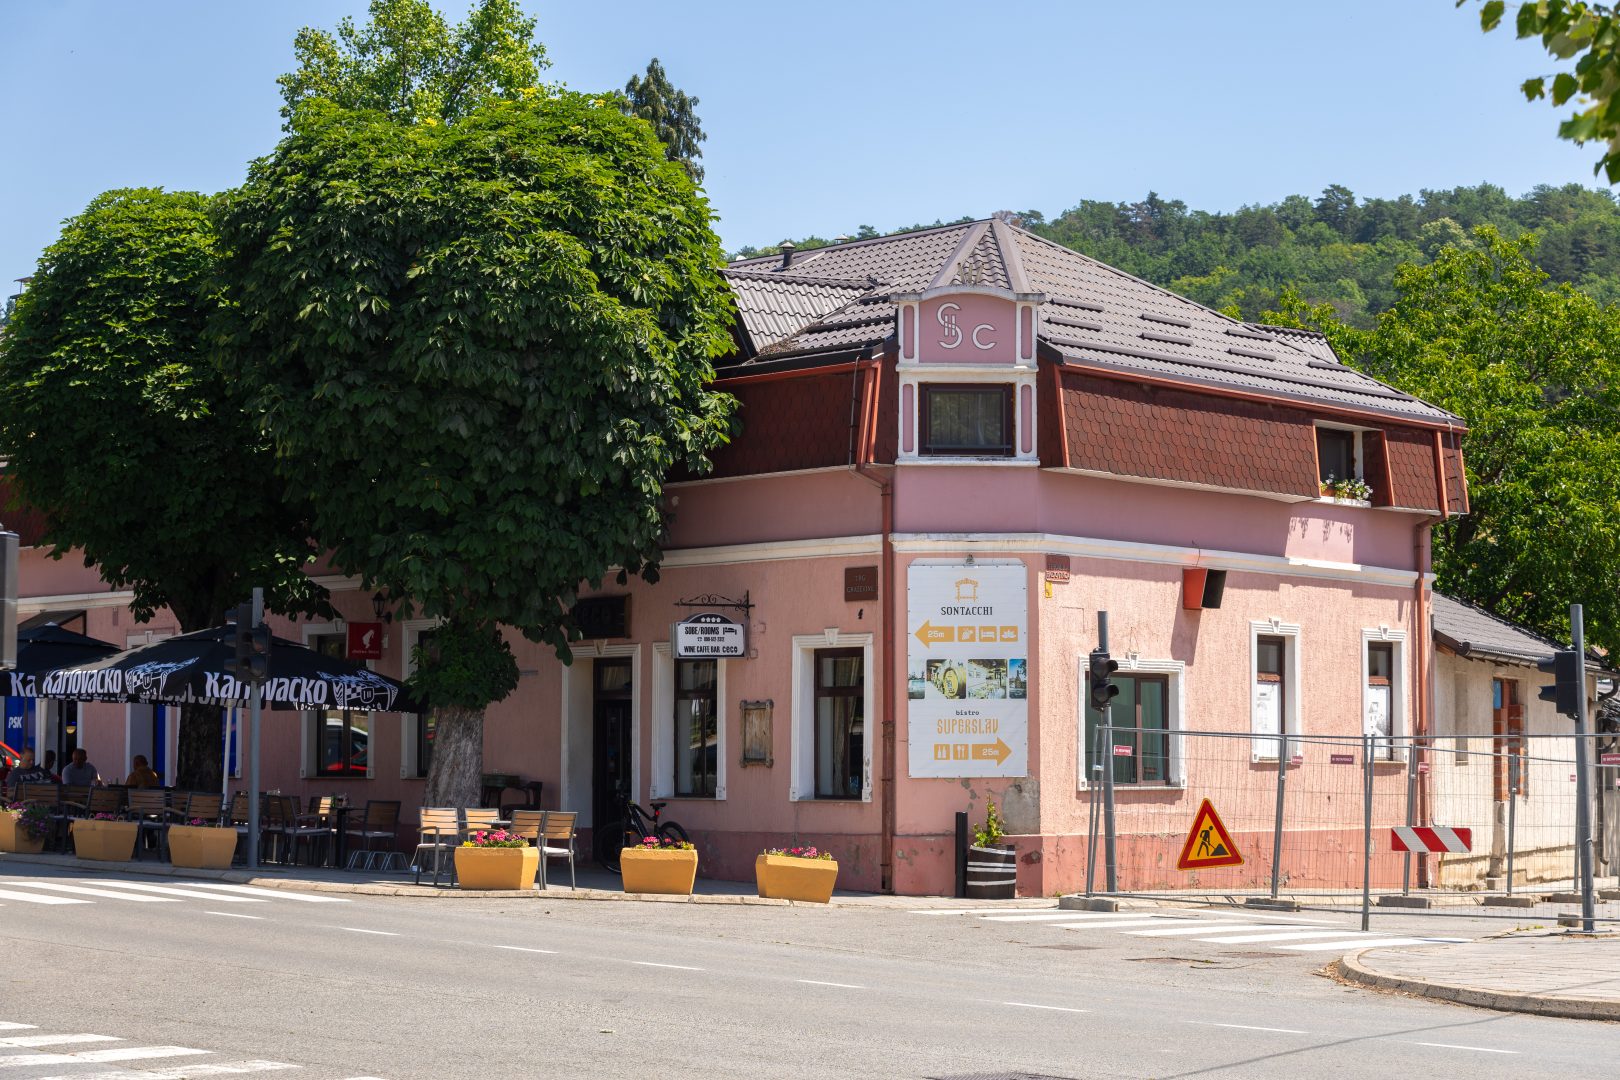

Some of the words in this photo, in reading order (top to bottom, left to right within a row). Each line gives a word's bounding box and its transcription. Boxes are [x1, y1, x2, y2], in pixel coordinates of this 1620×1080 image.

[940, 606, 993, 616] SONTACCHI
[684, 626, 720, 635] SOBE/ROOMS
[684, 645, 695, 653] WINE
[8, 716, 23, 729] PSK
[937, 718, 999, 735] SUPERSLAV
[982, 748, 1000, 756] 25m
